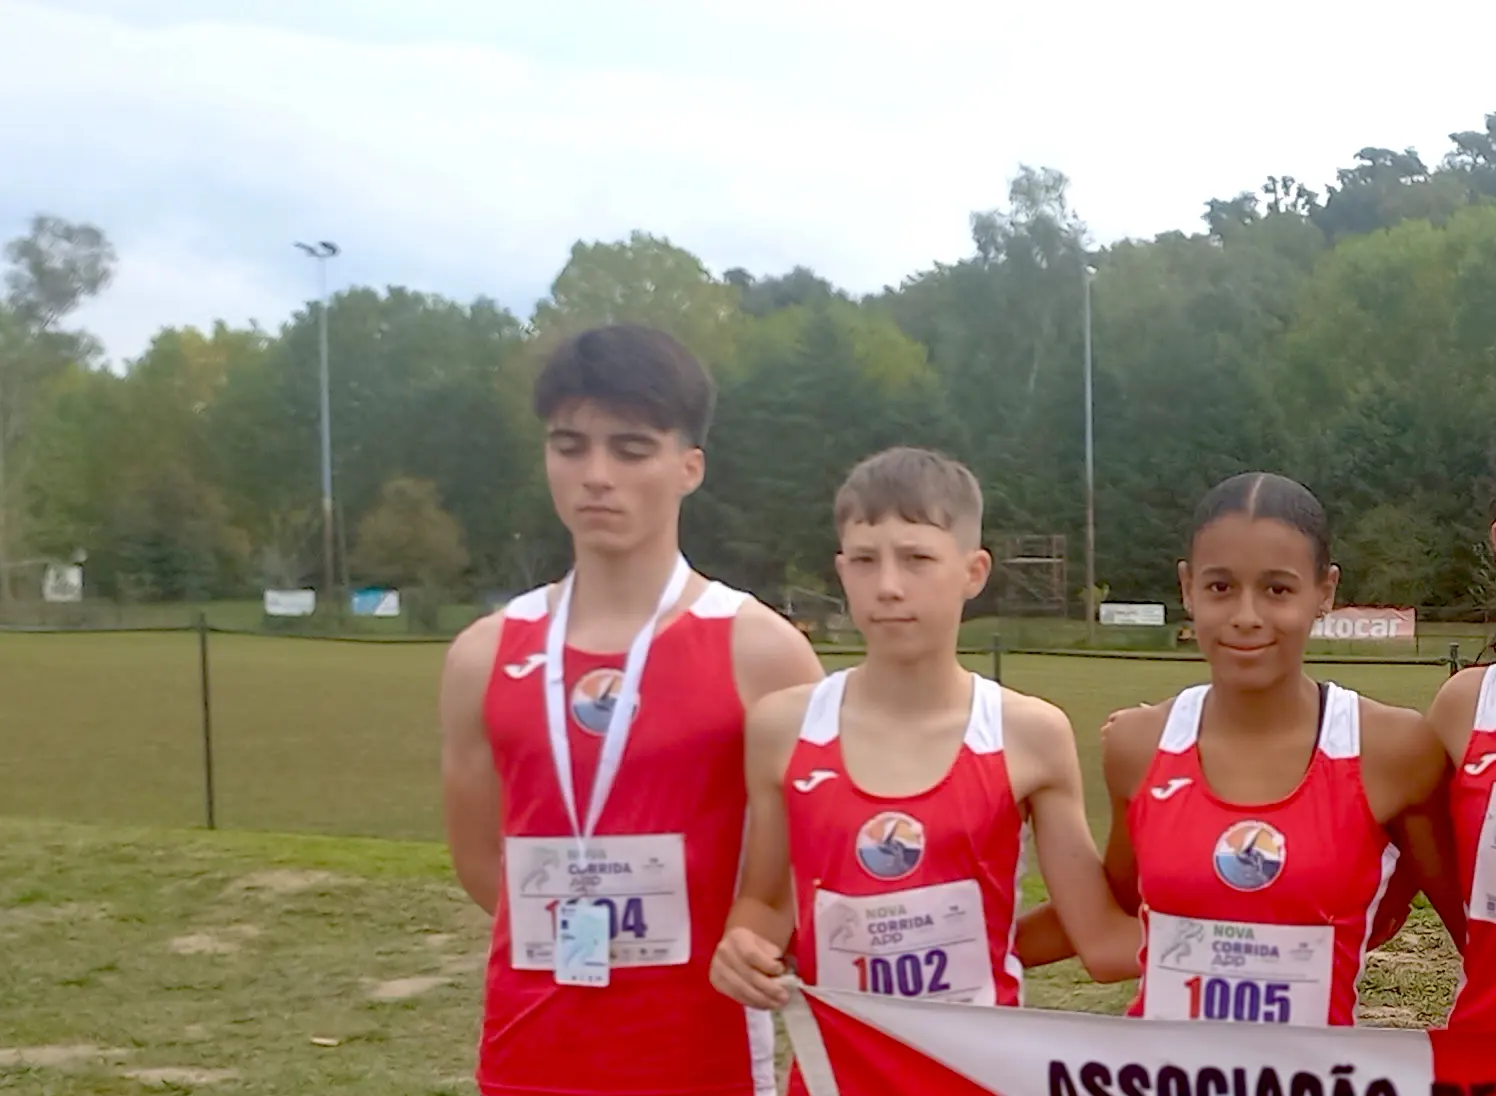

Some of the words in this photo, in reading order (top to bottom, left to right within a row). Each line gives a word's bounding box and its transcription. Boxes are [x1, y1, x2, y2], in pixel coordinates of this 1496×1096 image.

[545, 897, 648, 940] 104
[865, 904, 908, 920] NOVA
[867, 914, 935, 935] CORRIDA
[1213, 923, 1255, 940] NOVA
[869, 932, 904, 947] APP
[1211, 939, 1280, 959] CORRIDA
[1210, 955, 1246, 968] APP
[852, 948, 951, 997] 1002
[1184, 975, 1291, 1024] 1005
